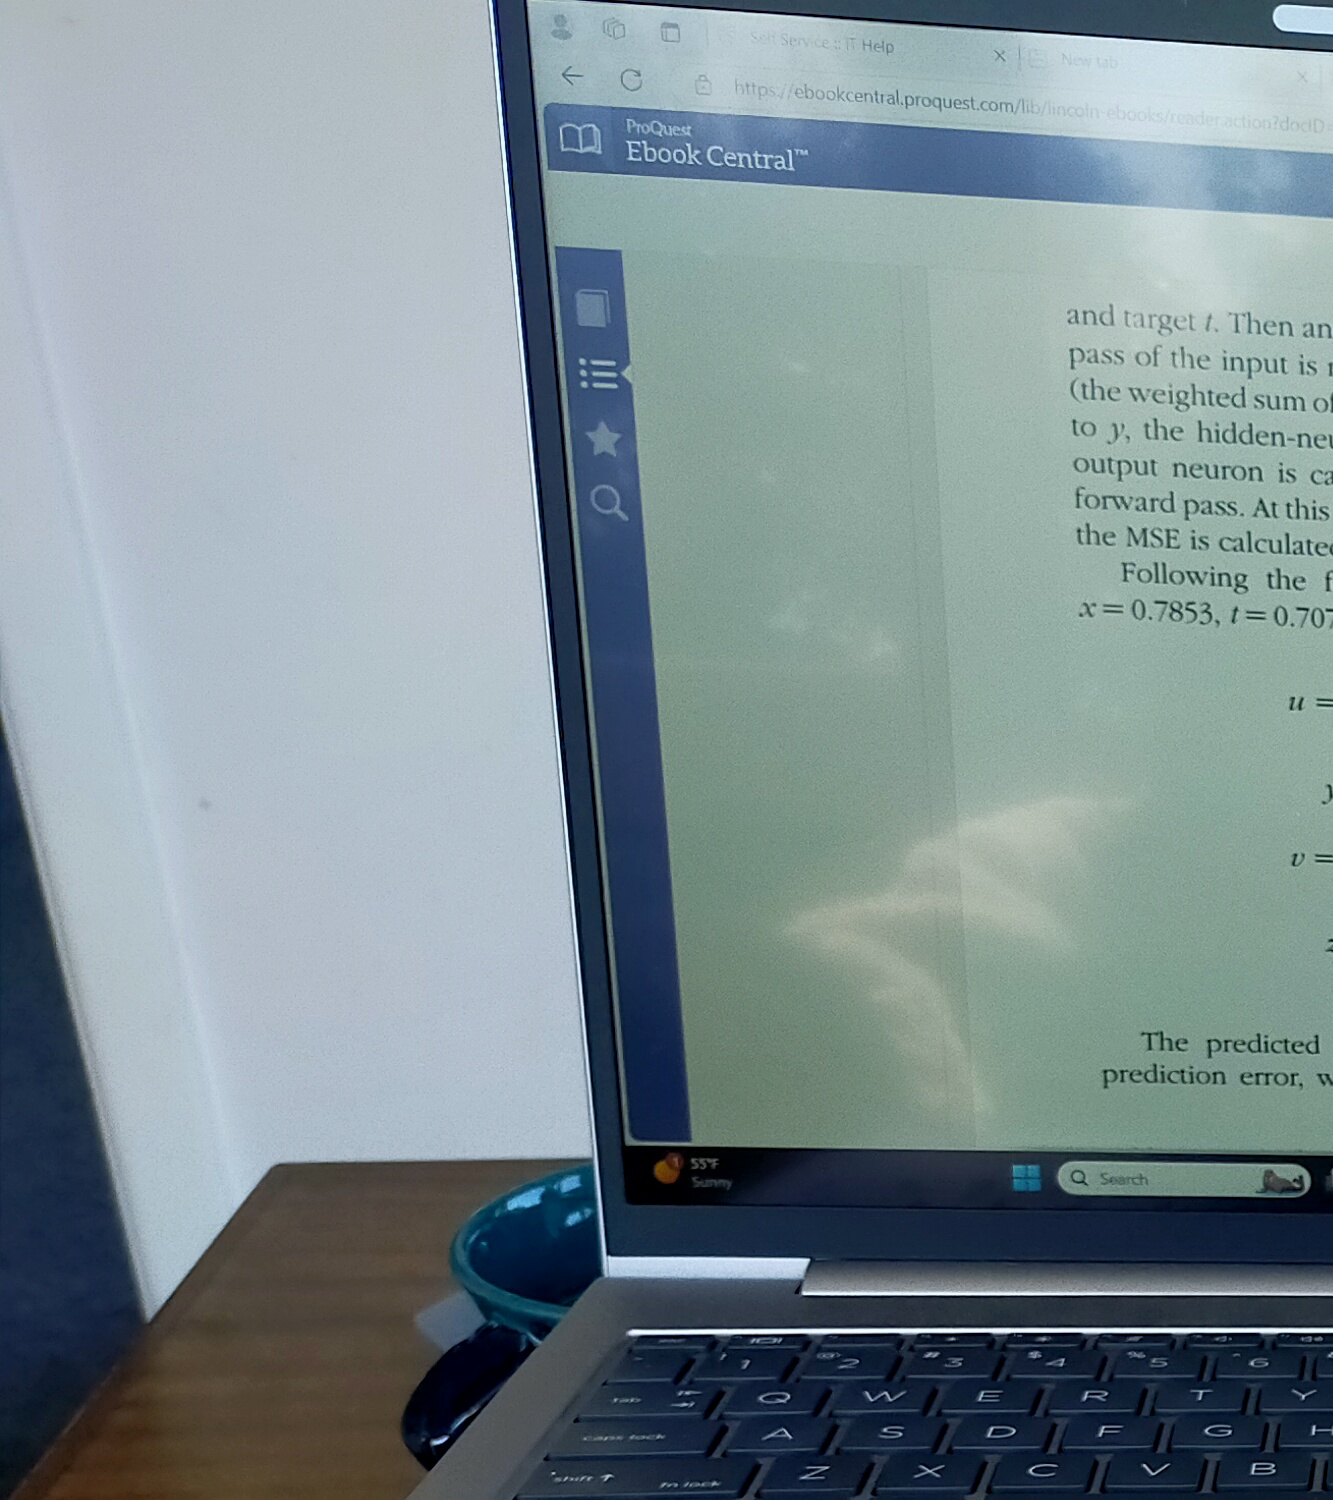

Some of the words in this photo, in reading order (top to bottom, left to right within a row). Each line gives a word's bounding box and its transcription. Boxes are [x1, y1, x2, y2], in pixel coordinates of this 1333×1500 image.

[861, 38, 895, 56] Help
[625, 118, 693, 137] ProQuest
[625, 140, 703, 166] Ebook
[1066, 302, 1116, 327] and
[1123, 309, 1196, 337] target
[1227, 310, 1295, 338] Then
[1302, 321, 1333, 340] an
[1068, 346, 1125, 371] pass
[1134, 344, 1163, 368] of
[1170, 345, 1211, 371] the
[1221, 349, 1288, 380] input
[1298, 353, 1318, 376] is
[1071, 418, 1098, 437] to
[1143, 417, 1185, 442] the
[1074, 485, 1176, 514] forward
[1183, 498, 1245, 522] pass.
[1252, 497, 1279, 520] At
[1285, 496, 1331, 521] this
[1075, 522, 1117, 547] the
[1126, 525, 1181, 550] MSE
[1190, 529, 1210, 551] is
[1120, 561, 1250, 595] Following
[1266, 567, 1307, 592] the
[1139, 1030, 1189, 1053] The
[1205, 1032, 1321, 1060] predicted
[1101, 1062, 1227, 1090] prediction
[1239, 1071, 1304, 1090] error,
[1100, 1170, 1149, 1189] Search
